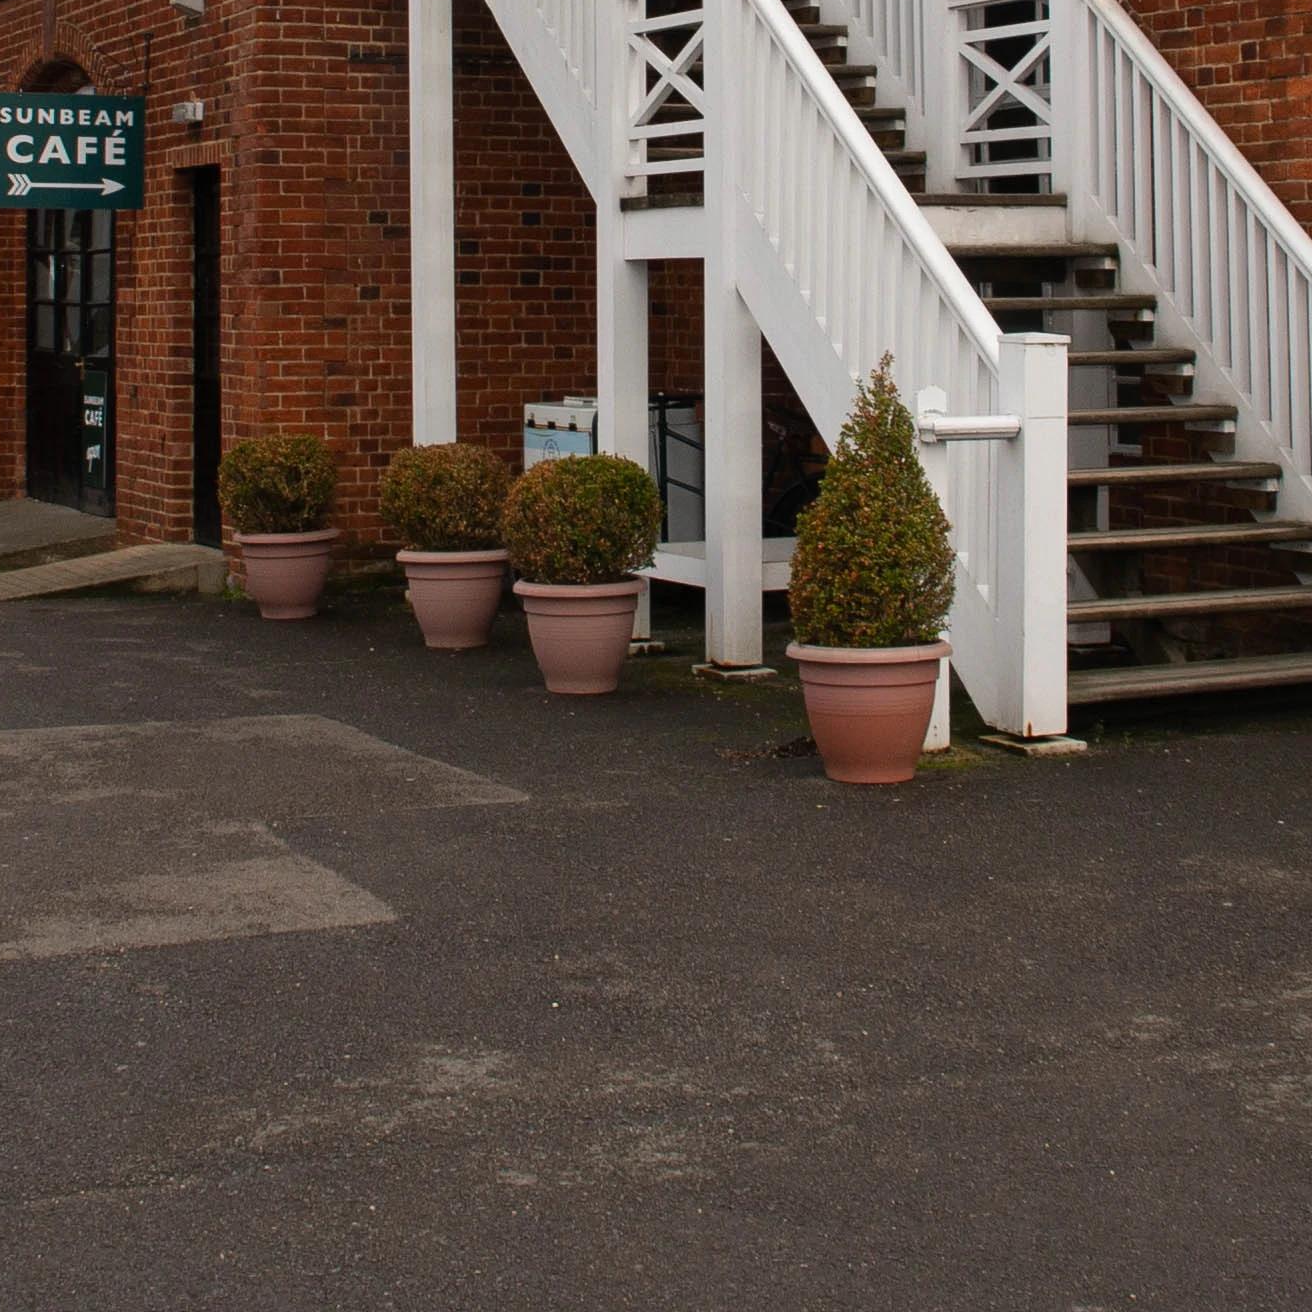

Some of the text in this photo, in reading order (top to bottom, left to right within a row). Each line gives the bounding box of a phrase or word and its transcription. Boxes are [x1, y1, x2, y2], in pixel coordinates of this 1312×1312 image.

[0, 106, 134, 127] SUNBEAM
[6, 129, 127, 166] CAFÉ
[84, 407, 103, 426] CAFÉ
